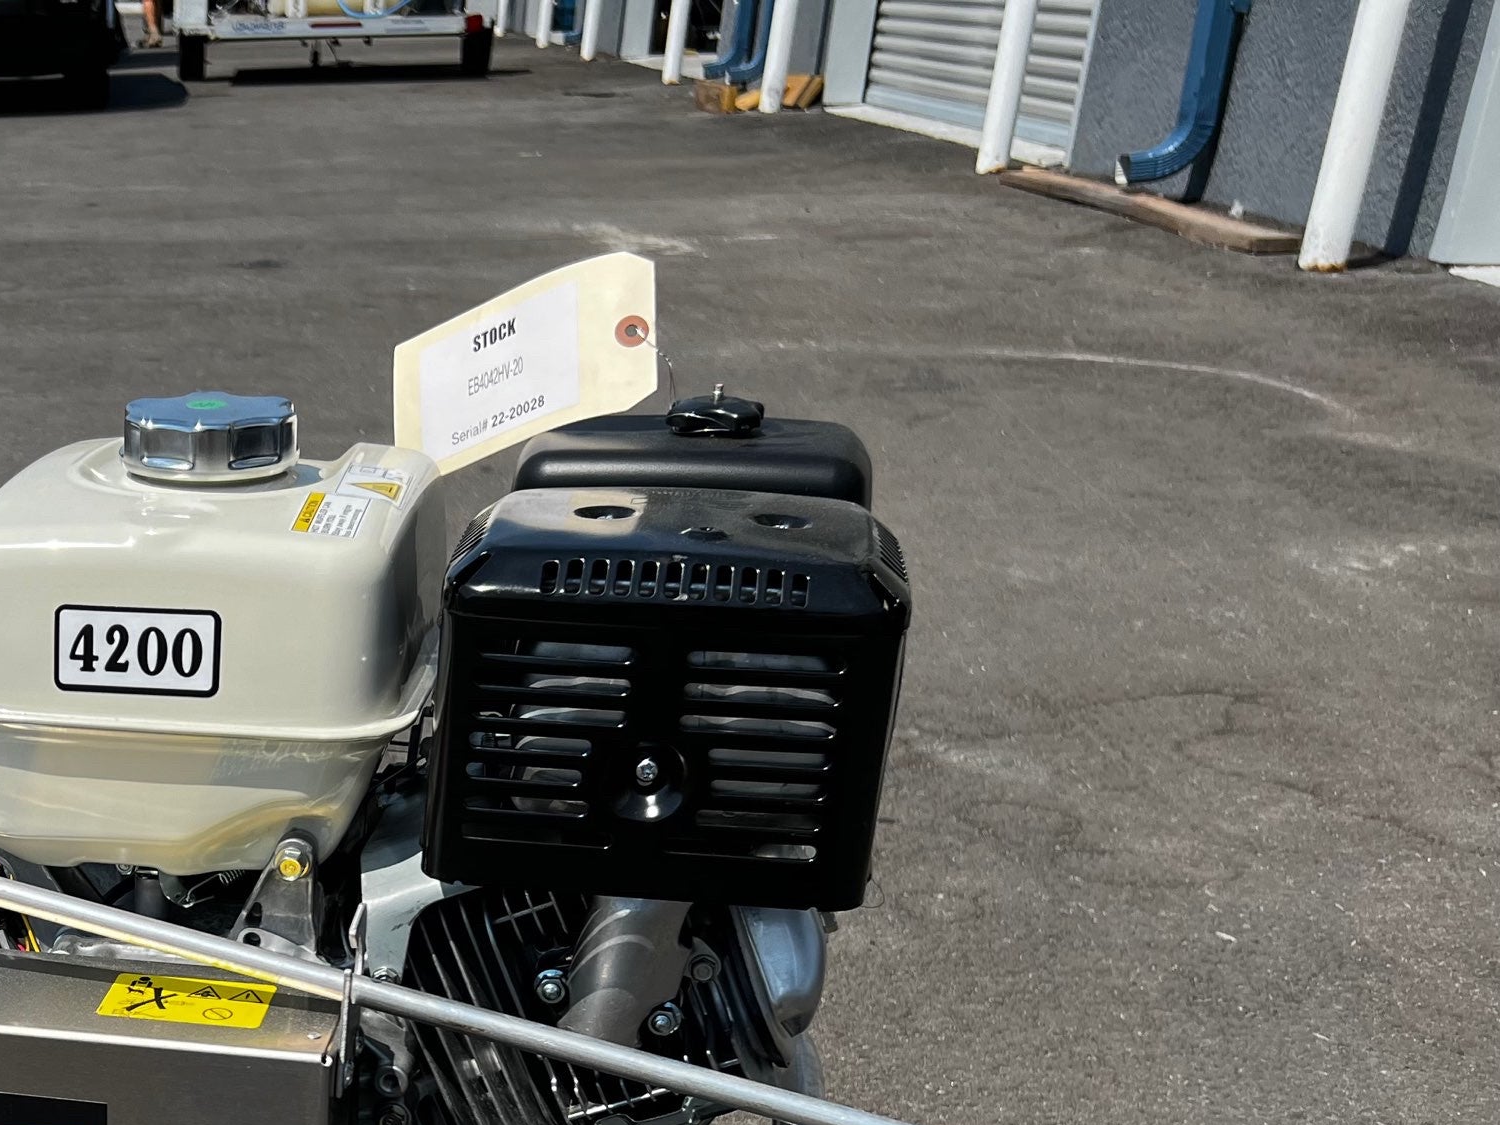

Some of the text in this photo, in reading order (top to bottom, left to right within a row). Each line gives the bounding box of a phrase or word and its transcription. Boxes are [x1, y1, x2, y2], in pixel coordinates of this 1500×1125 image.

[473, 317, 516, 352] STOCK
[468, 356, 524, 396] EB4042HV-20
[452, 395, 545, 445] Serial# 22-20028
[69, 624, 203, 678] 4200
